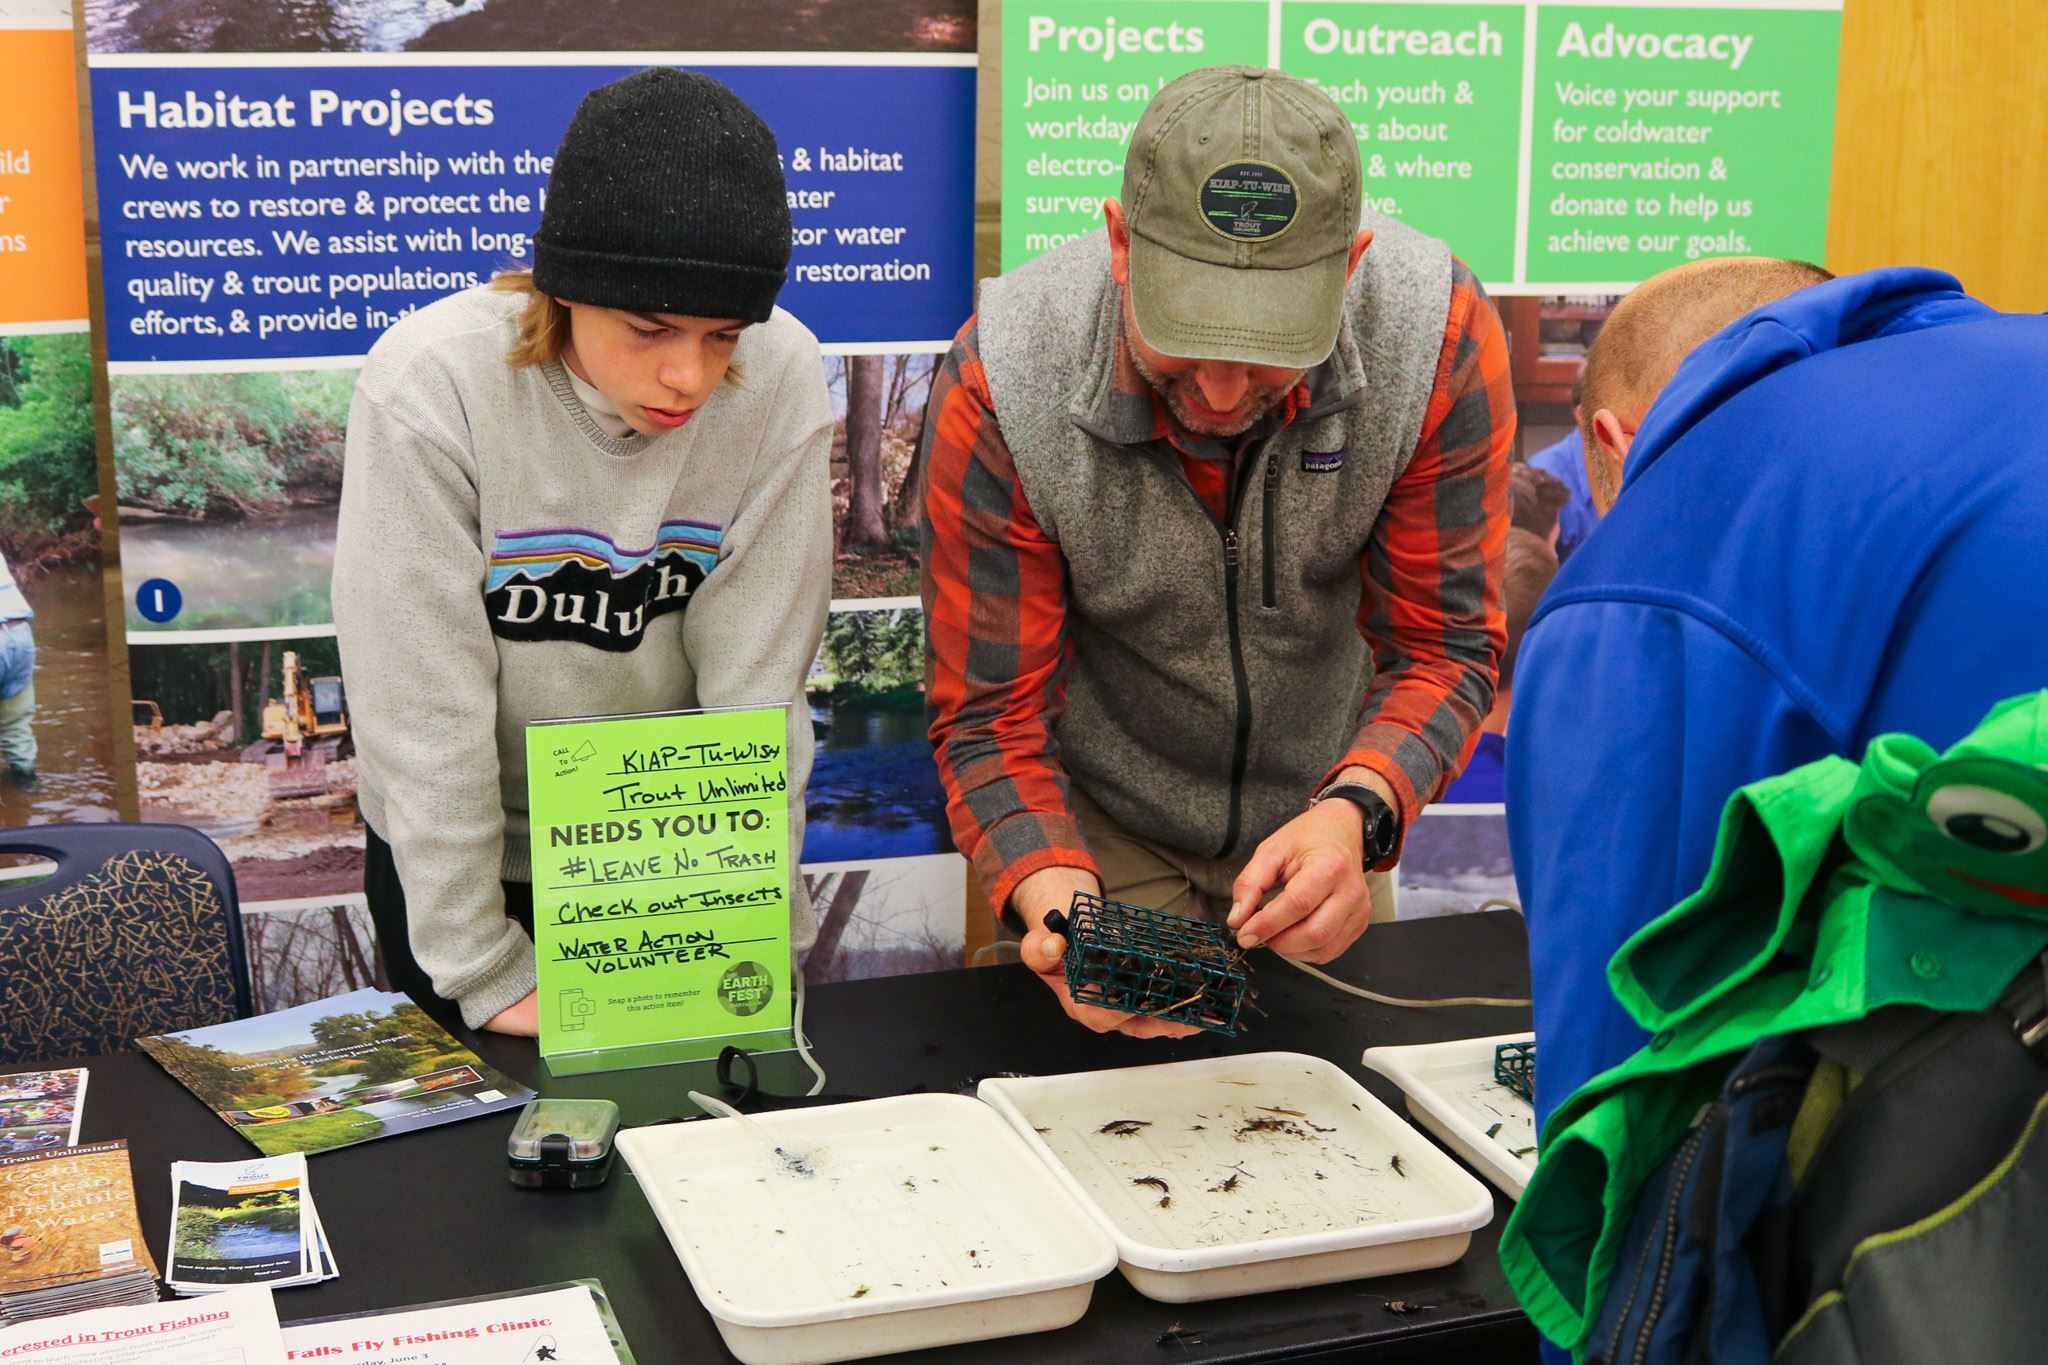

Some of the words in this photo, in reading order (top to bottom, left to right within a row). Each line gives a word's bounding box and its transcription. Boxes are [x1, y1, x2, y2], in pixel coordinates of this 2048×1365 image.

[1028, 16, 1204, 62] Projects
[1303, 19, 1502, 56] Outreach
[1557, 23, 1753, 69] Advocacy
[1024, 77, 1072, 108] Join
[1082, 83, 1108, 101] us
[1117, 83, 1149, 101] on
[1377, 80, 1446, 110] youth
[1455, 81, 1473, 104] &
[1555, 80, 1615, 107] Voice
[1622, 84, 1679, 112] your
[1686, 86, 1781, 113] support
[118, 91, 295, 129] Habitat
[310, 89, 494, 136] Projects
[1377, 117, 1448, 141] about
[1553, 118, 1587, 143] for
[1593, 119, 1712, 144] coldwater
[119, 153, 168, 180] We
[176, 151, 248, 179] work
[256, 155, 279, 177] in
[290, 151, 439, 183] partnership
[447, 150, 505, 176] with
[514, 149, 554, 175] the
[792, 148, 812, 171] &
[820, 147, 903, 171] habitat
[1368, 154, 1386, 178] &
[1395, 154, 1472, 179] where
[1551, 156, 1699, 180] conservation
[1707, 156, 1727, 180] &
[1209, 179, 1291, 193] KIAP-TU-WISH
[123, 199, 201, 219] crews
[210, 199, 240, 217] to
[249, 195, 346, 217] restore
[355, 191, 376, 214] &
[384, 192, 480, 221] protect
[487, 190, 530, 213] the
[1550, 192, 1628, 218] donate
[1635, 194, 1660, 217] to
[1668, 192, 1719, 223] help
[1726, 198, 1753, 218] us
[1233, 221, 1261, 229] TROUT
[126, 236, 263, 258] resources.
[272, 230, 320, 255] We
[329, 231, 398, 254] assist
[405, 229, 462, 252] with
[834, 225, 907, 245] water
[1547, 229, 1632, 253] achieve
[1638, 234, 1680, 253] our
[1685, 230, 1752, 259] goals.
[127, 272, 214, 303] quality
[223, 271, 244, 294] &
[252, 272, 321, 294] trout
[796, 259, 931, 282] restoration
[131, 308, 223, 337] efforts,
[230, 310, 251, 332] &
[259, 308, 357, 339] provide
[498, 565, 690, 637] Duluh
[553, 748, 570, 756] CALL
[604, 782, 686, 810] Trout
[699, 771, 787, 803] Unlimited
[551, 819, 643, 847] NEEDS
[652, 813, 716, 838] YOU
[726, 808, 770, 833] TO:
[560, 856, 661, 883] #LEAVE
[647, 893, 686, 914] out
[689, 885, 783, 907] Insects
[586, 943, 730, 974] VOLUNTEER
[633, 995, 653, 1003] photo
[664, 989, 700, 999] remember
[723, 975, 768, 990] EARTH
[728, 988, 762, 1002] FEST
[643, 1002, 665, 1010] action
[231, 1056, 298, 1072] Celebrating
[299, 1052, 317, 1061] the
[319, 1042, 374, 1056] Economic
[375, 1032, 413, 1046] Impact
[351, 1046, 379, 1058] Jewel
[2, 1153, 41, 1165] Trout
[45, 1142, 120, 1158] Unlimited
[8, 1190, 129, 1218] Fishable
[33, 1210, 121, 1229] Water
[78, 1333, 97, 1343] in
[101, 1325, 154, 1342] Trout
[160, 1310, 230, 1331] Fishing
[287, 1346, 343, 1360] Falls
[352, 1340, 384, 1352] Fly
[393, 1326, 479, 1347] Fishing
[486, 1318, 552, 1335] Clinic
[391, 1355, 418, 1363] June
